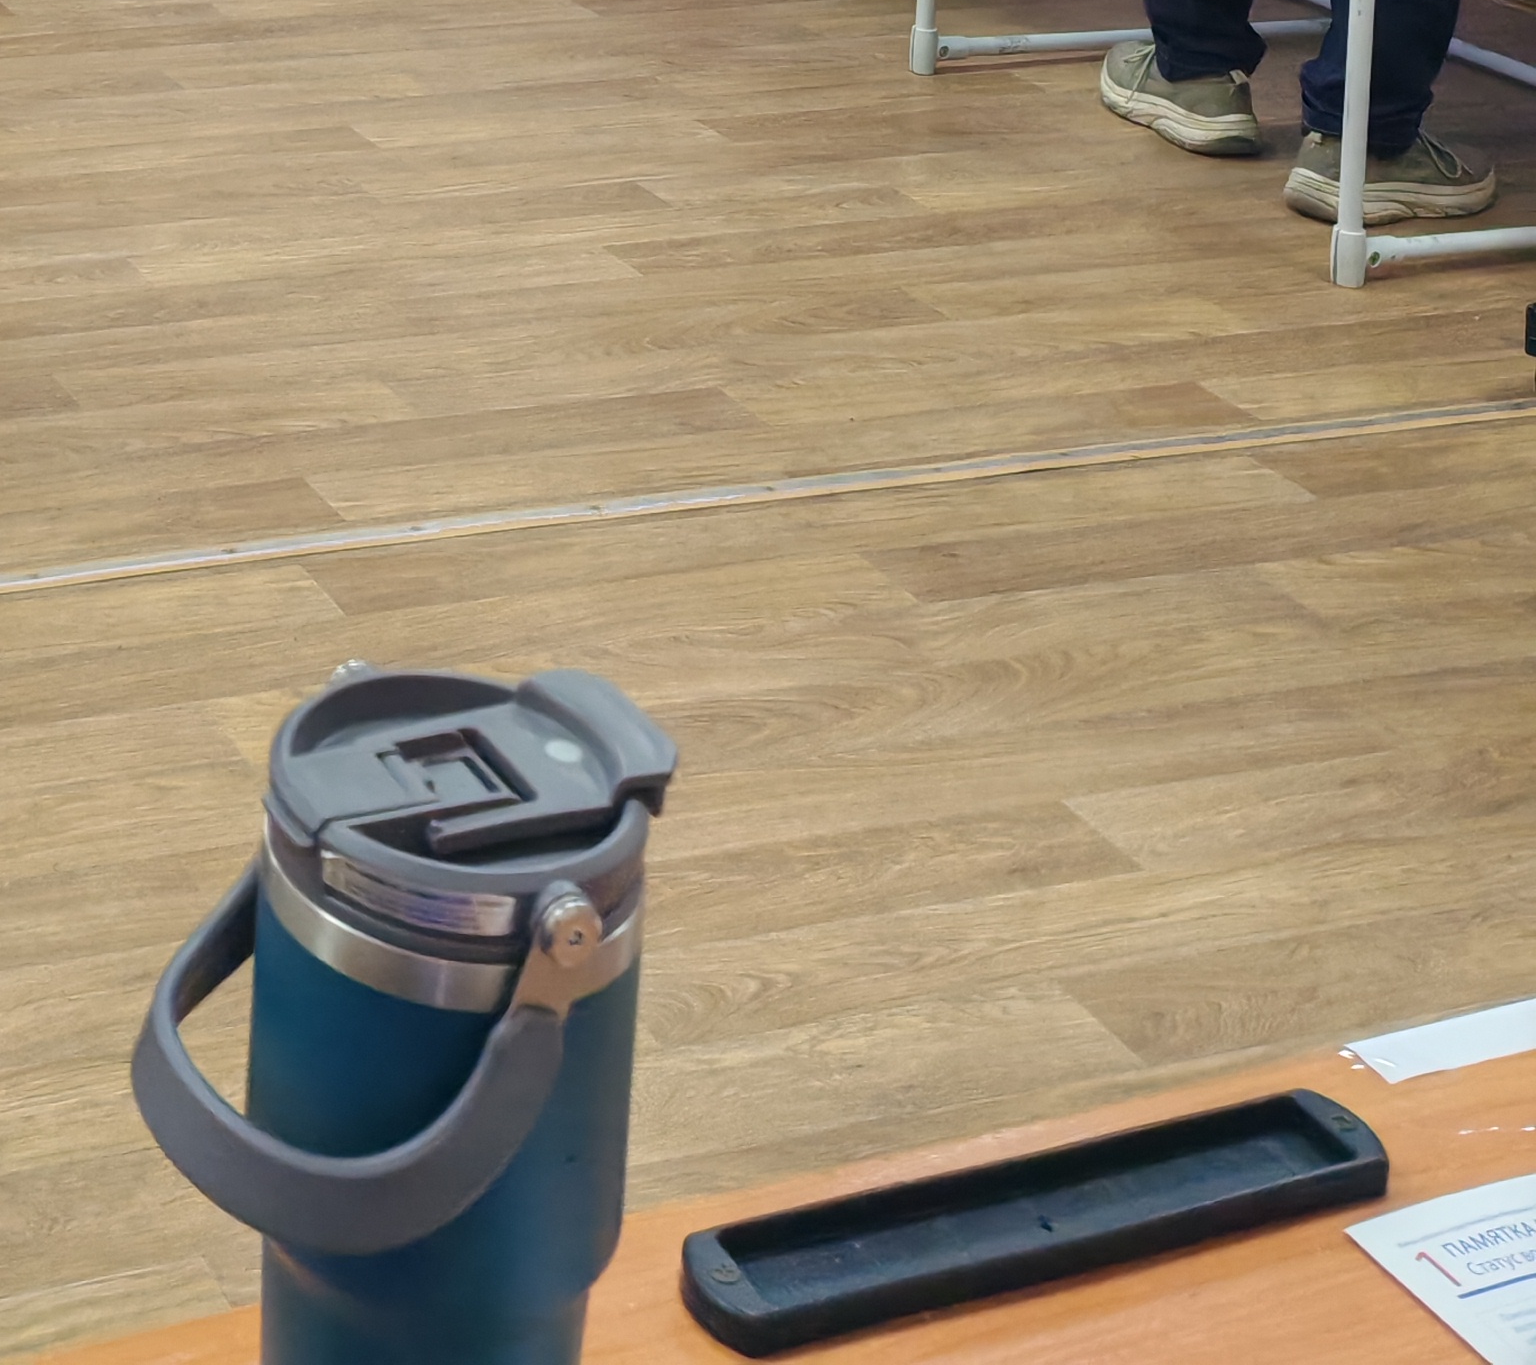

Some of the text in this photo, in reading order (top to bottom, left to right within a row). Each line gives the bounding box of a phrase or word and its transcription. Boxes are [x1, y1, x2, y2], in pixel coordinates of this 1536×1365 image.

[1441, 1221, 1536, 1258] ПАМЯТКА
[1415, 1251, 1462, 1287] 1
[1466, 1253, 1522, 1275] Статус
